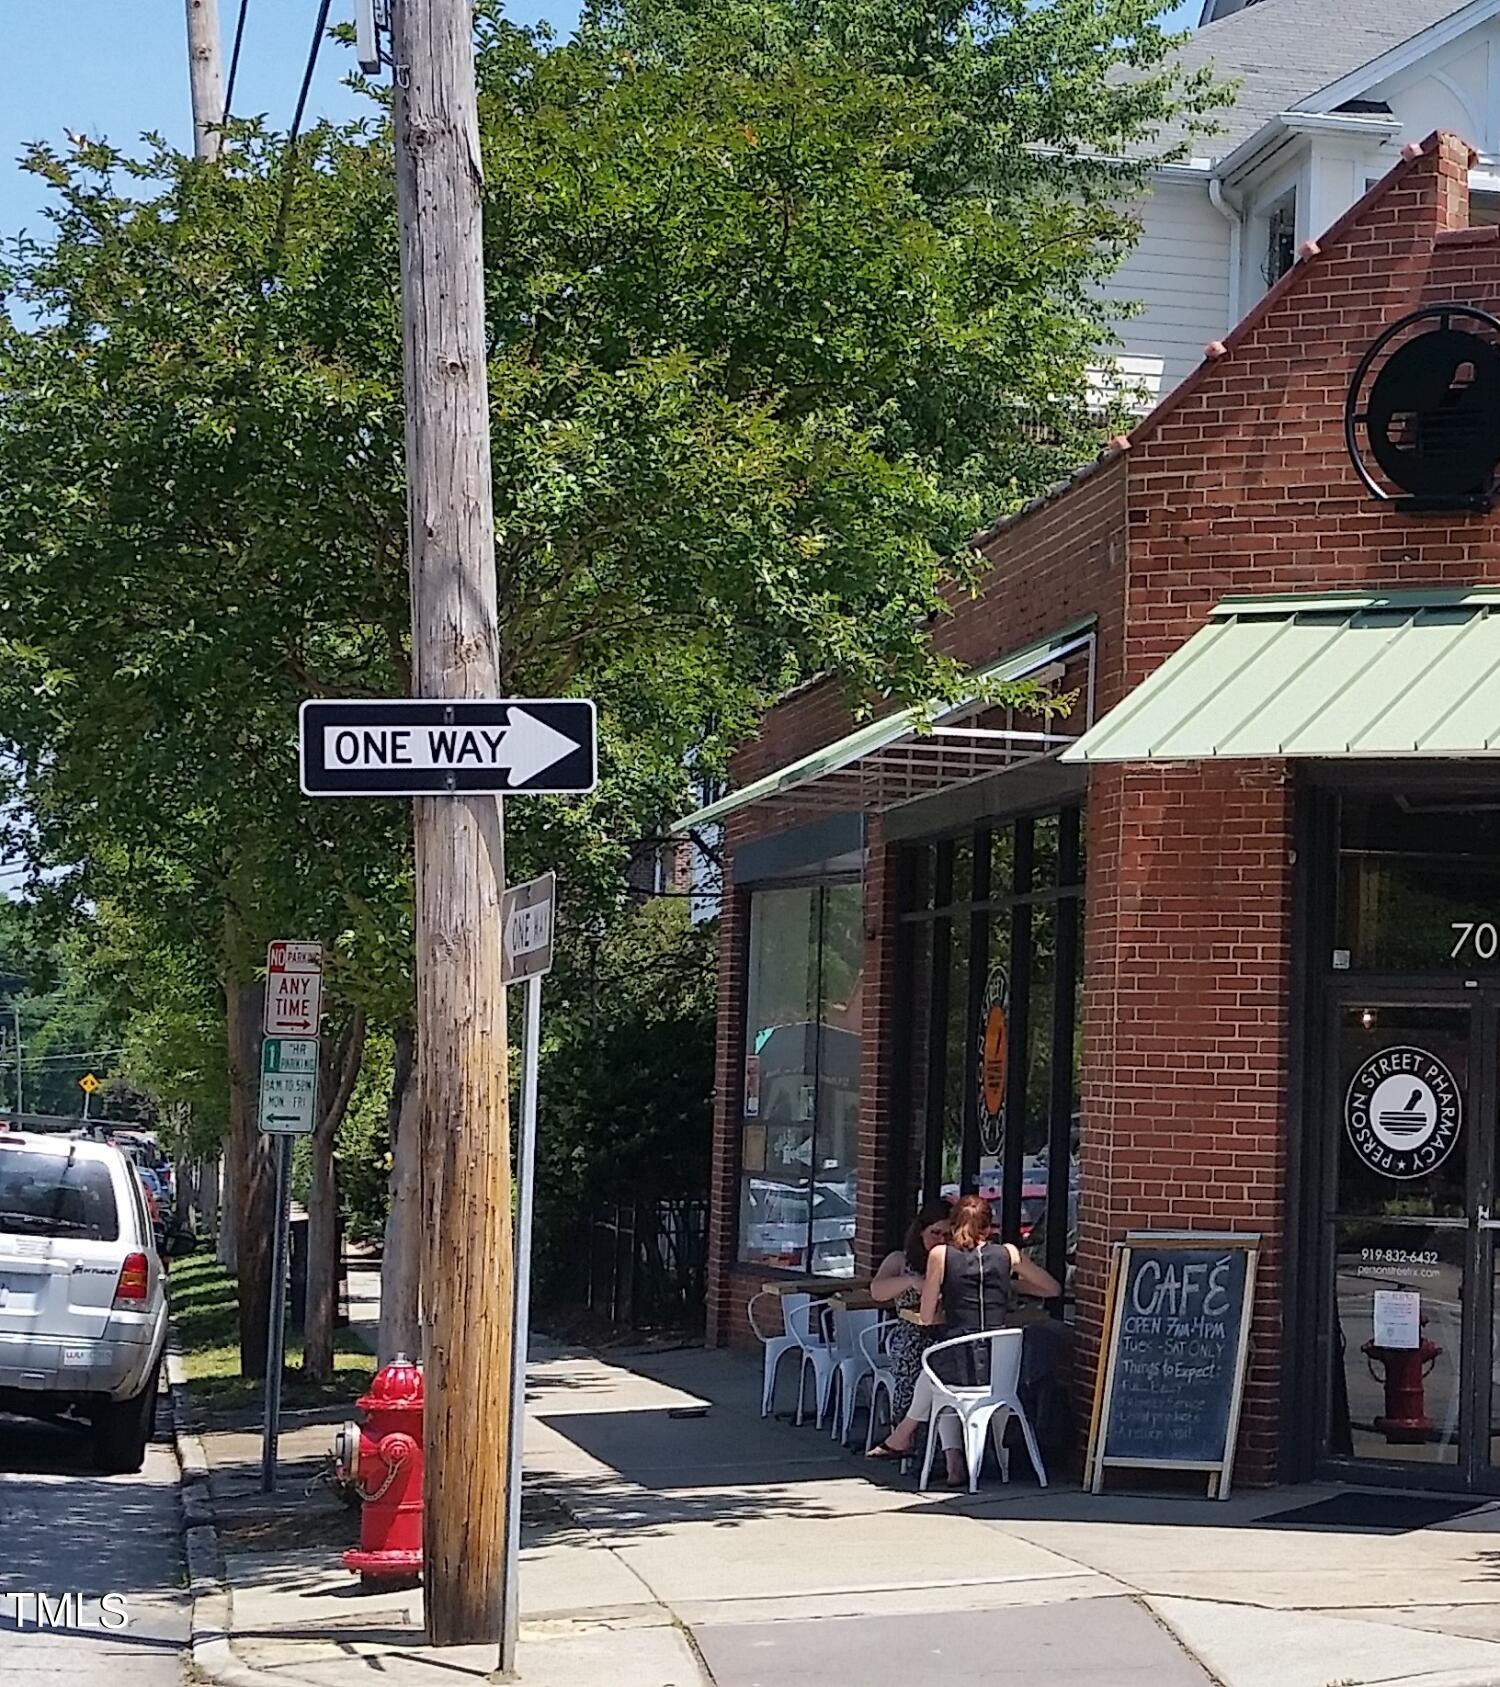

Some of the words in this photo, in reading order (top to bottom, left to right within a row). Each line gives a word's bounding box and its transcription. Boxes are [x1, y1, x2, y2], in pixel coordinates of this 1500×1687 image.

[335, 731, 412, 764] ONE
[429, 731, 507, 764] WAY
[512, 912, 530, 951] ONE
[271, 948, 286, 966] NO
[288, 952, 320, 963] PARK
[279, 978, 310, 995] ANY
[276, 999, 310, 1016] TIME
[269, 1044, 276, 1068] 1
[293, 1044, 306, 1055] HR
[1361, 1053, 1424, 1088] STREET
[1413, 1065, 1456, 1171] PHARMACY
[1351, 1092, 1393, 1169] PERSON
[1361, 1248, 1438, 1265] 919-832-6432
[1133, 1255, 1232, 1316] CAFÉ
[1124, 1316, 1161, 1334] OPEN
[1163, 1359, 1174, 1377] to
